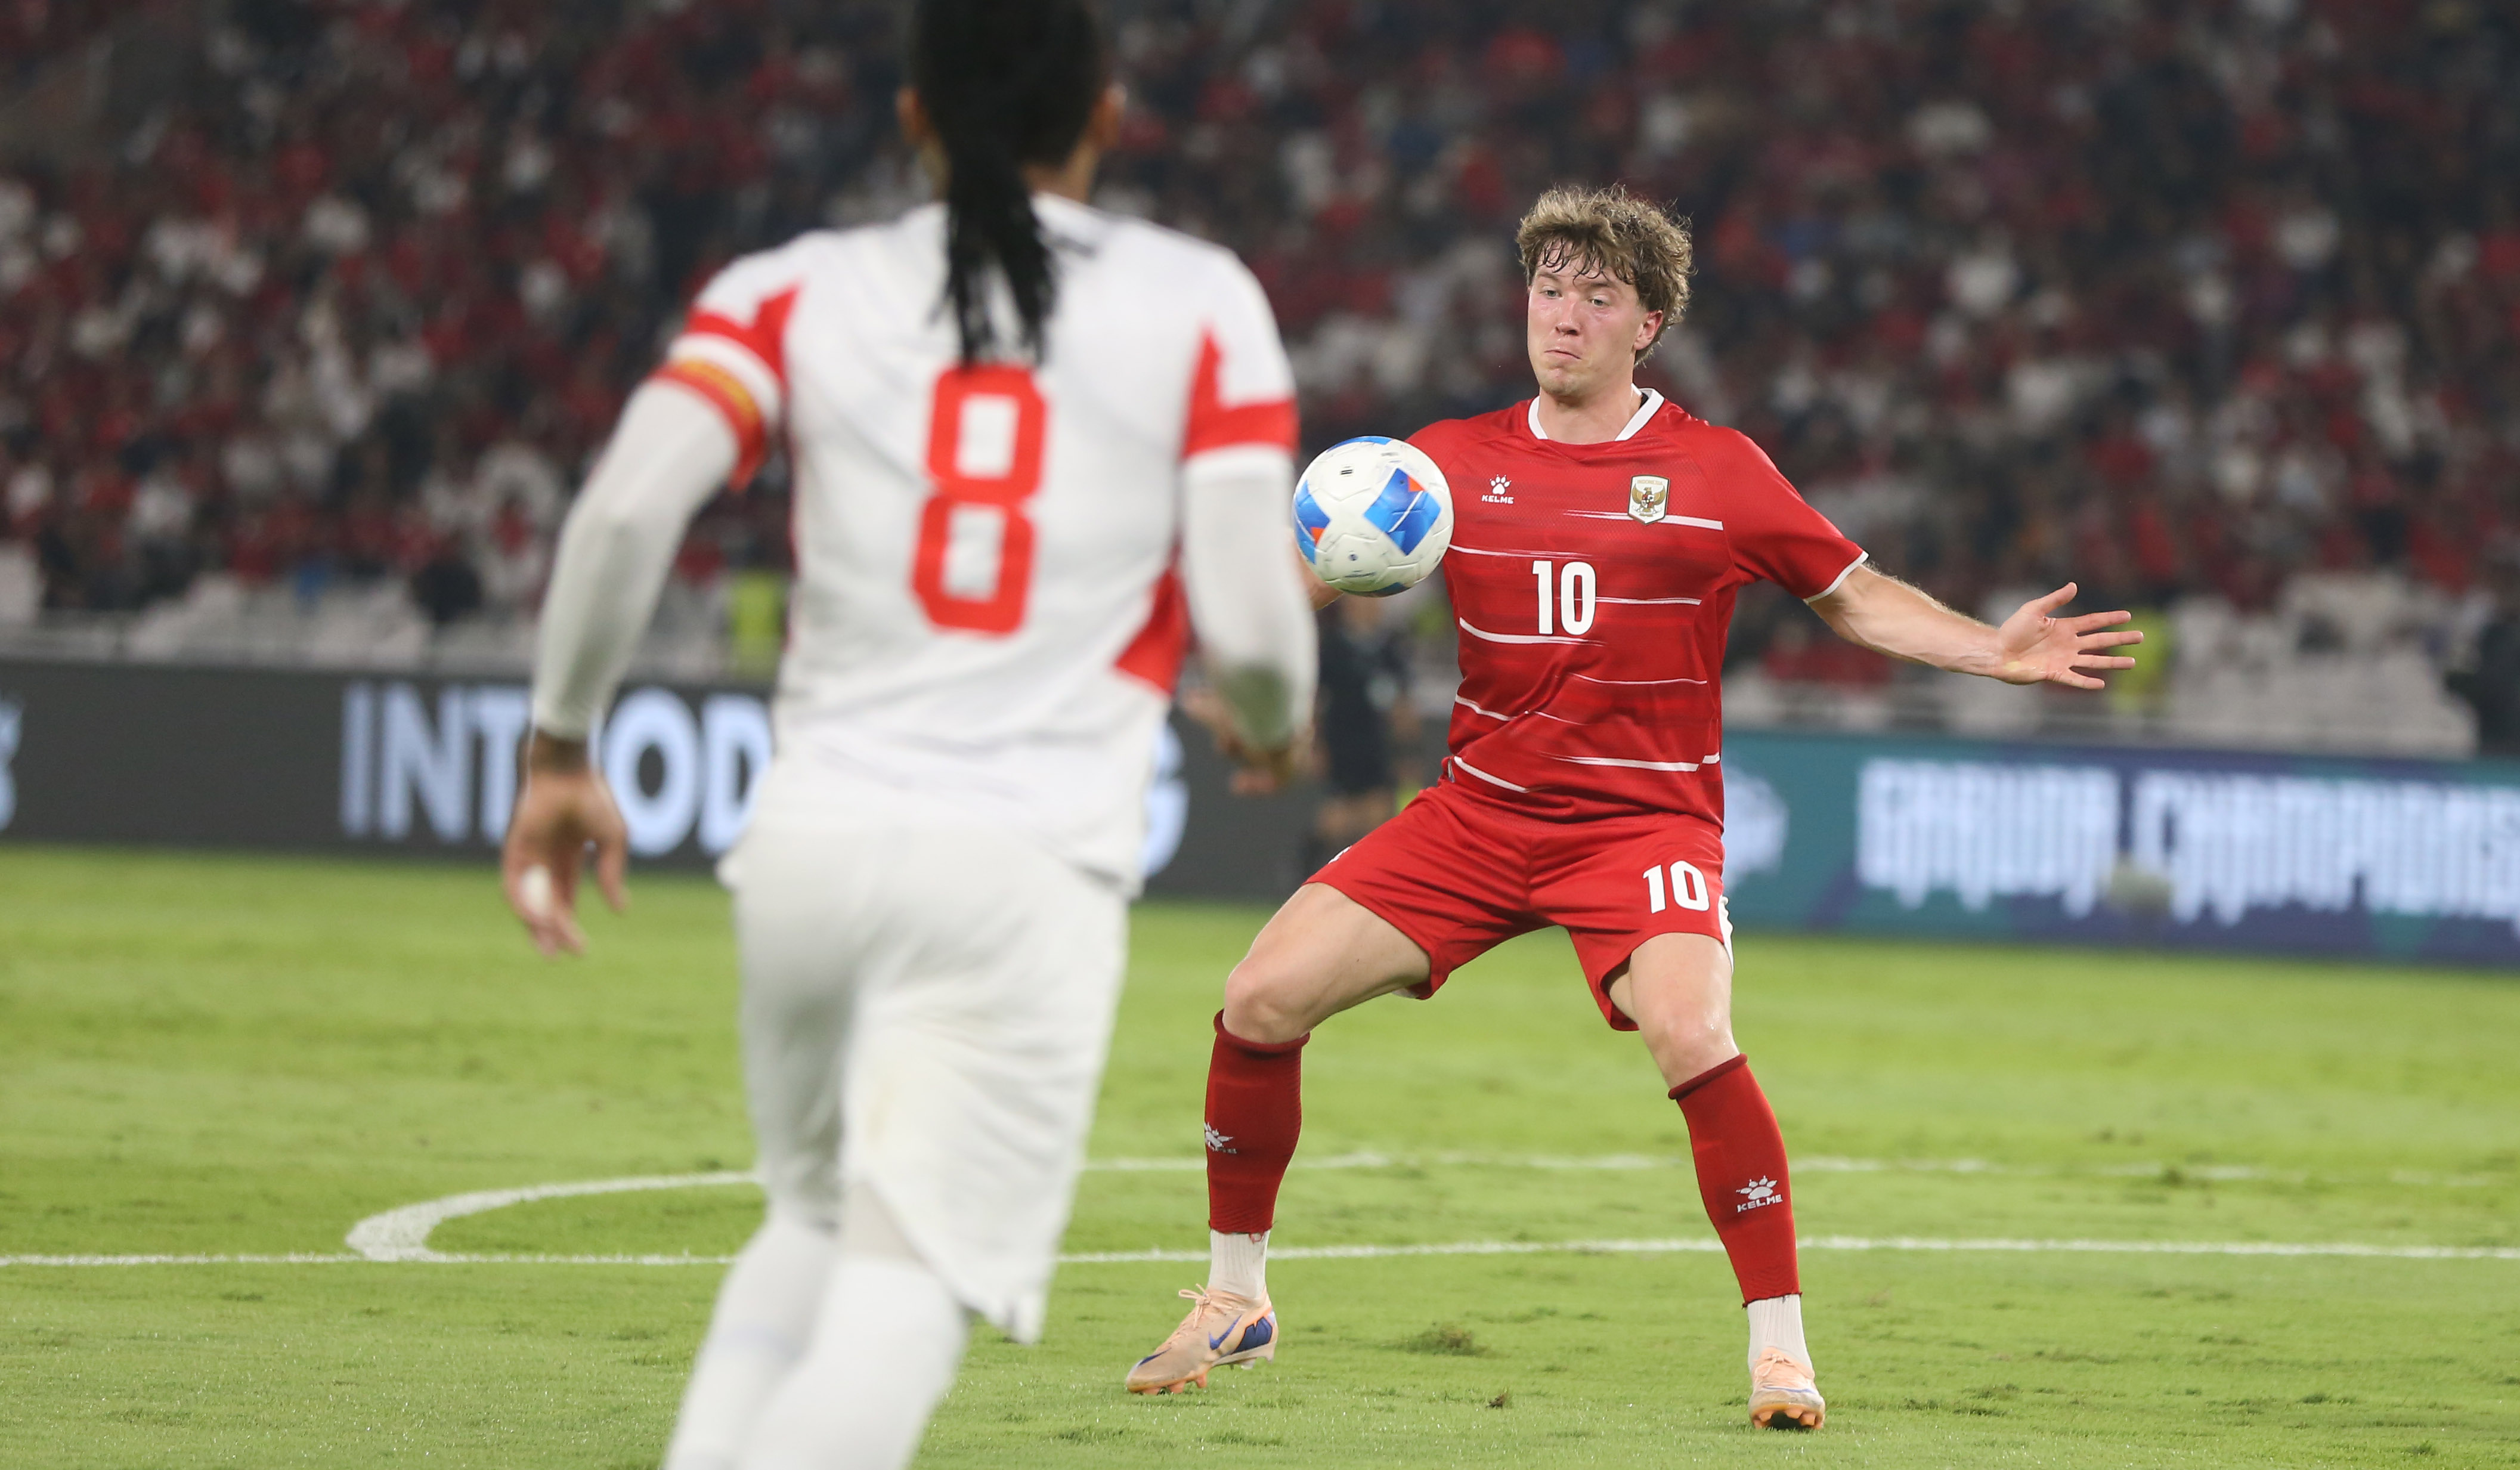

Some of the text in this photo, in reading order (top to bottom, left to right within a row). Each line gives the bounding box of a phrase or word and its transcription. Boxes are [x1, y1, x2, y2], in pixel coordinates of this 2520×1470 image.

[910, 363, 1048, 637] 8
[1481, 494, 1514, 505] KELME
[1531, 560, 1596, 636] 10
[1642, 859, 1710, 914] 10
[1737, 1194, 1783, 1213] KELME
